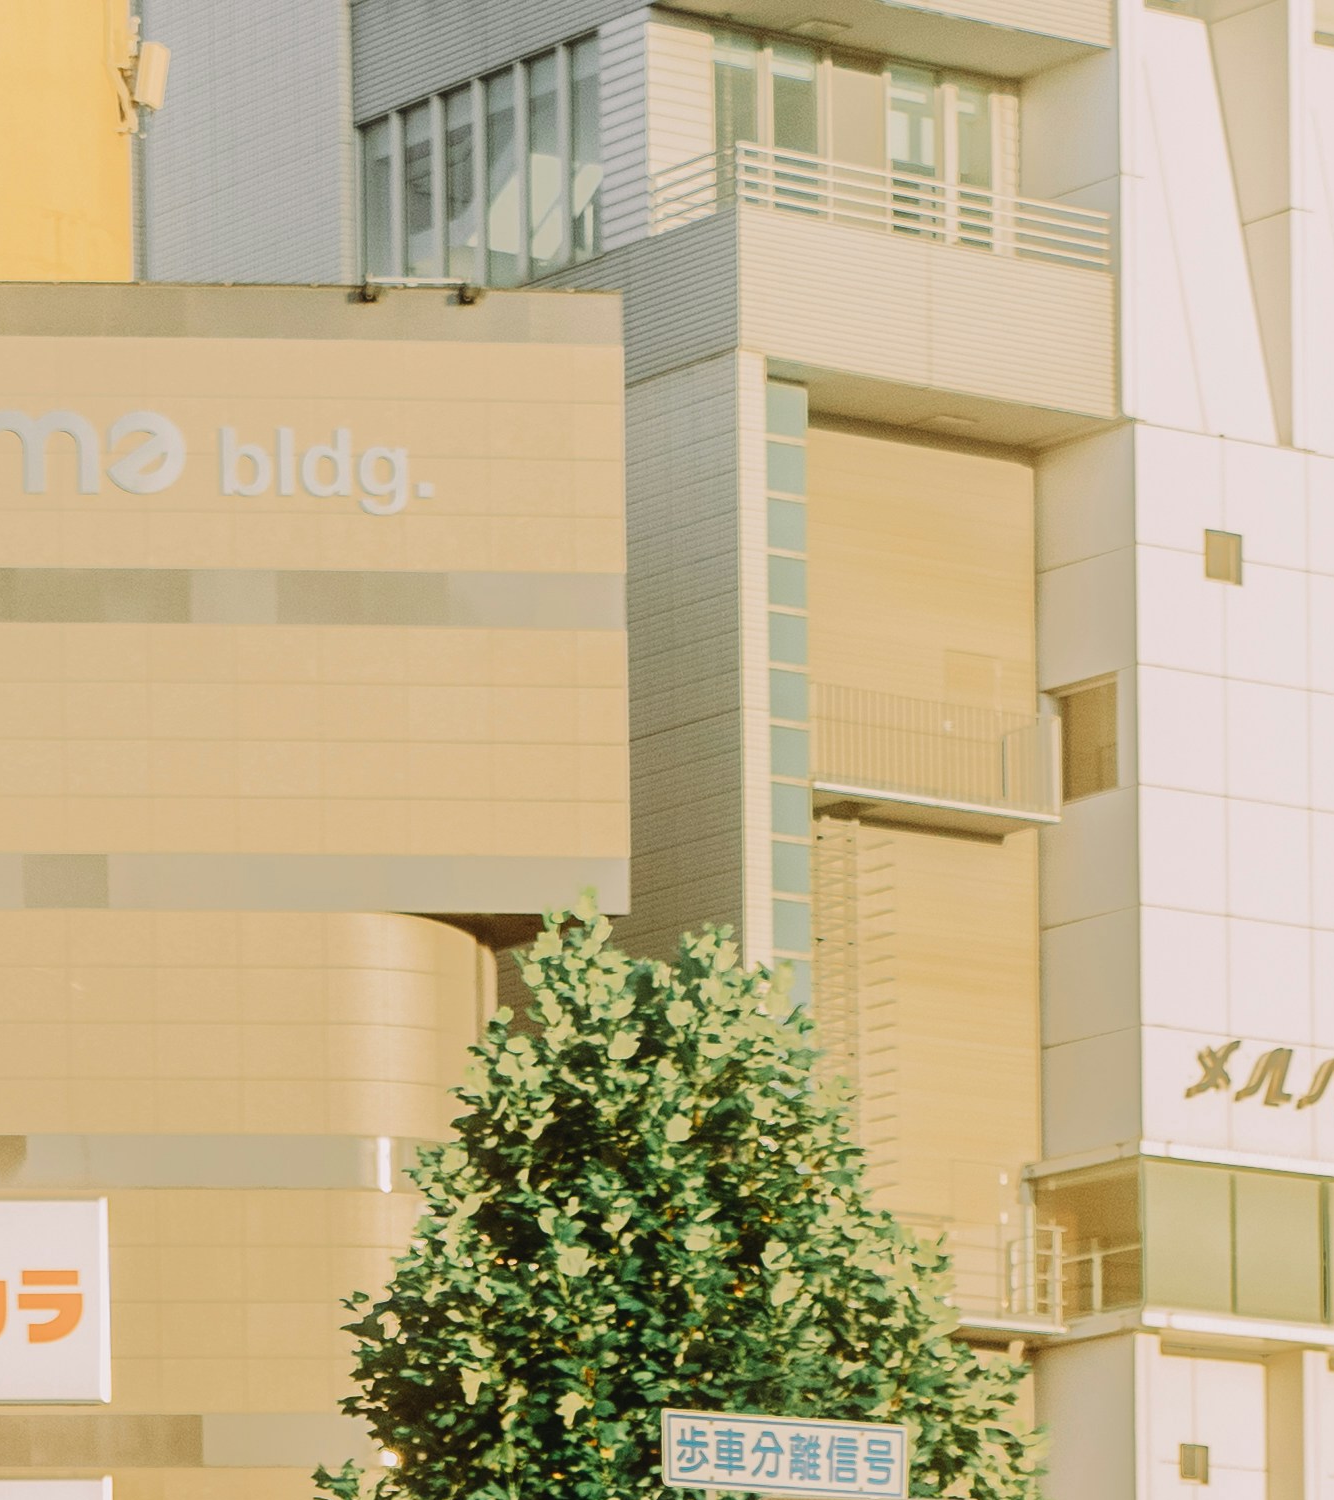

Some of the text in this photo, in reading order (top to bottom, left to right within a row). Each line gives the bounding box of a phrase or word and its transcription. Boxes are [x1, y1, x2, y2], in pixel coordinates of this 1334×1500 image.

[219, 425, 436, 516] bldg.
[675, 1425, 895, 1487] 歩車分離信号
